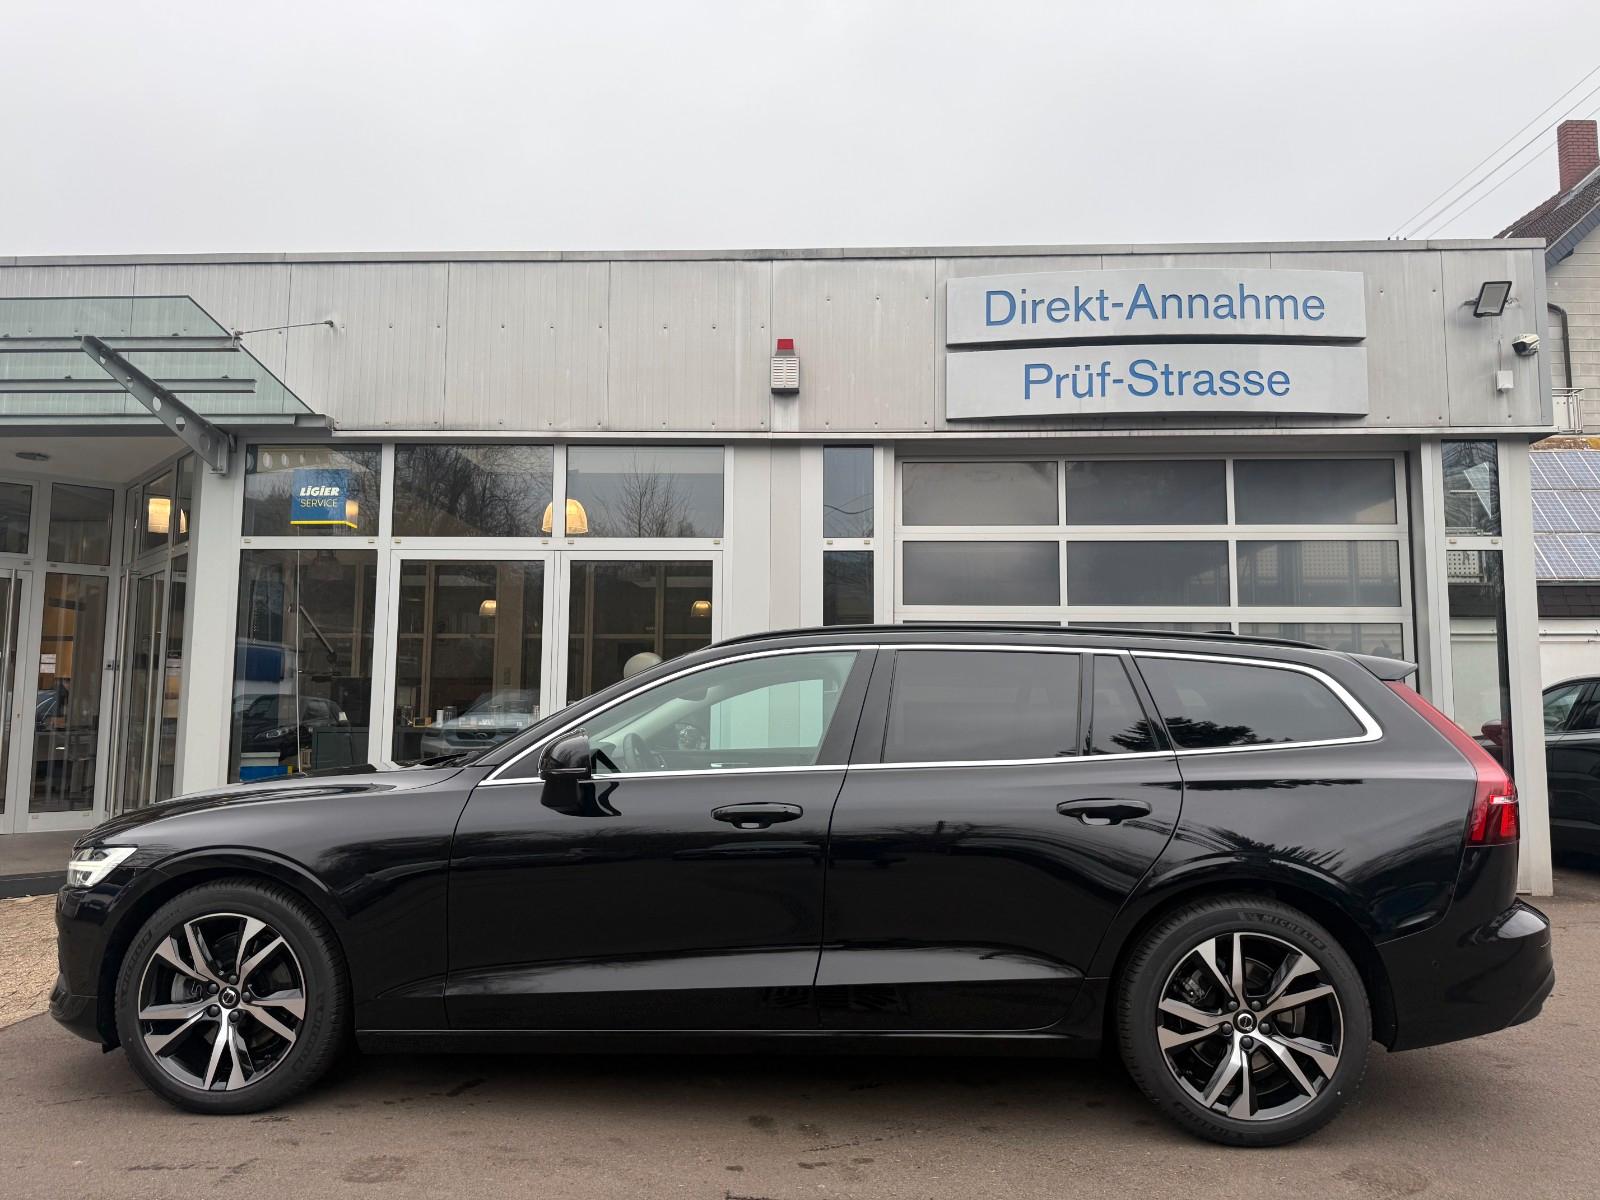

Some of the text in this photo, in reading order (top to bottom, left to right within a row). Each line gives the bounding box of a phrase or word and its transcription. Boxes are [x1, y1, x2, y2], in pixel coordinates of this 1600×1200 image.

[985, 283, 1325, 326] Direkt-Annahme
[1024, 359, 1290, 399] Prüf-Strasse
[300, 498, 338, 508] SERVICE
